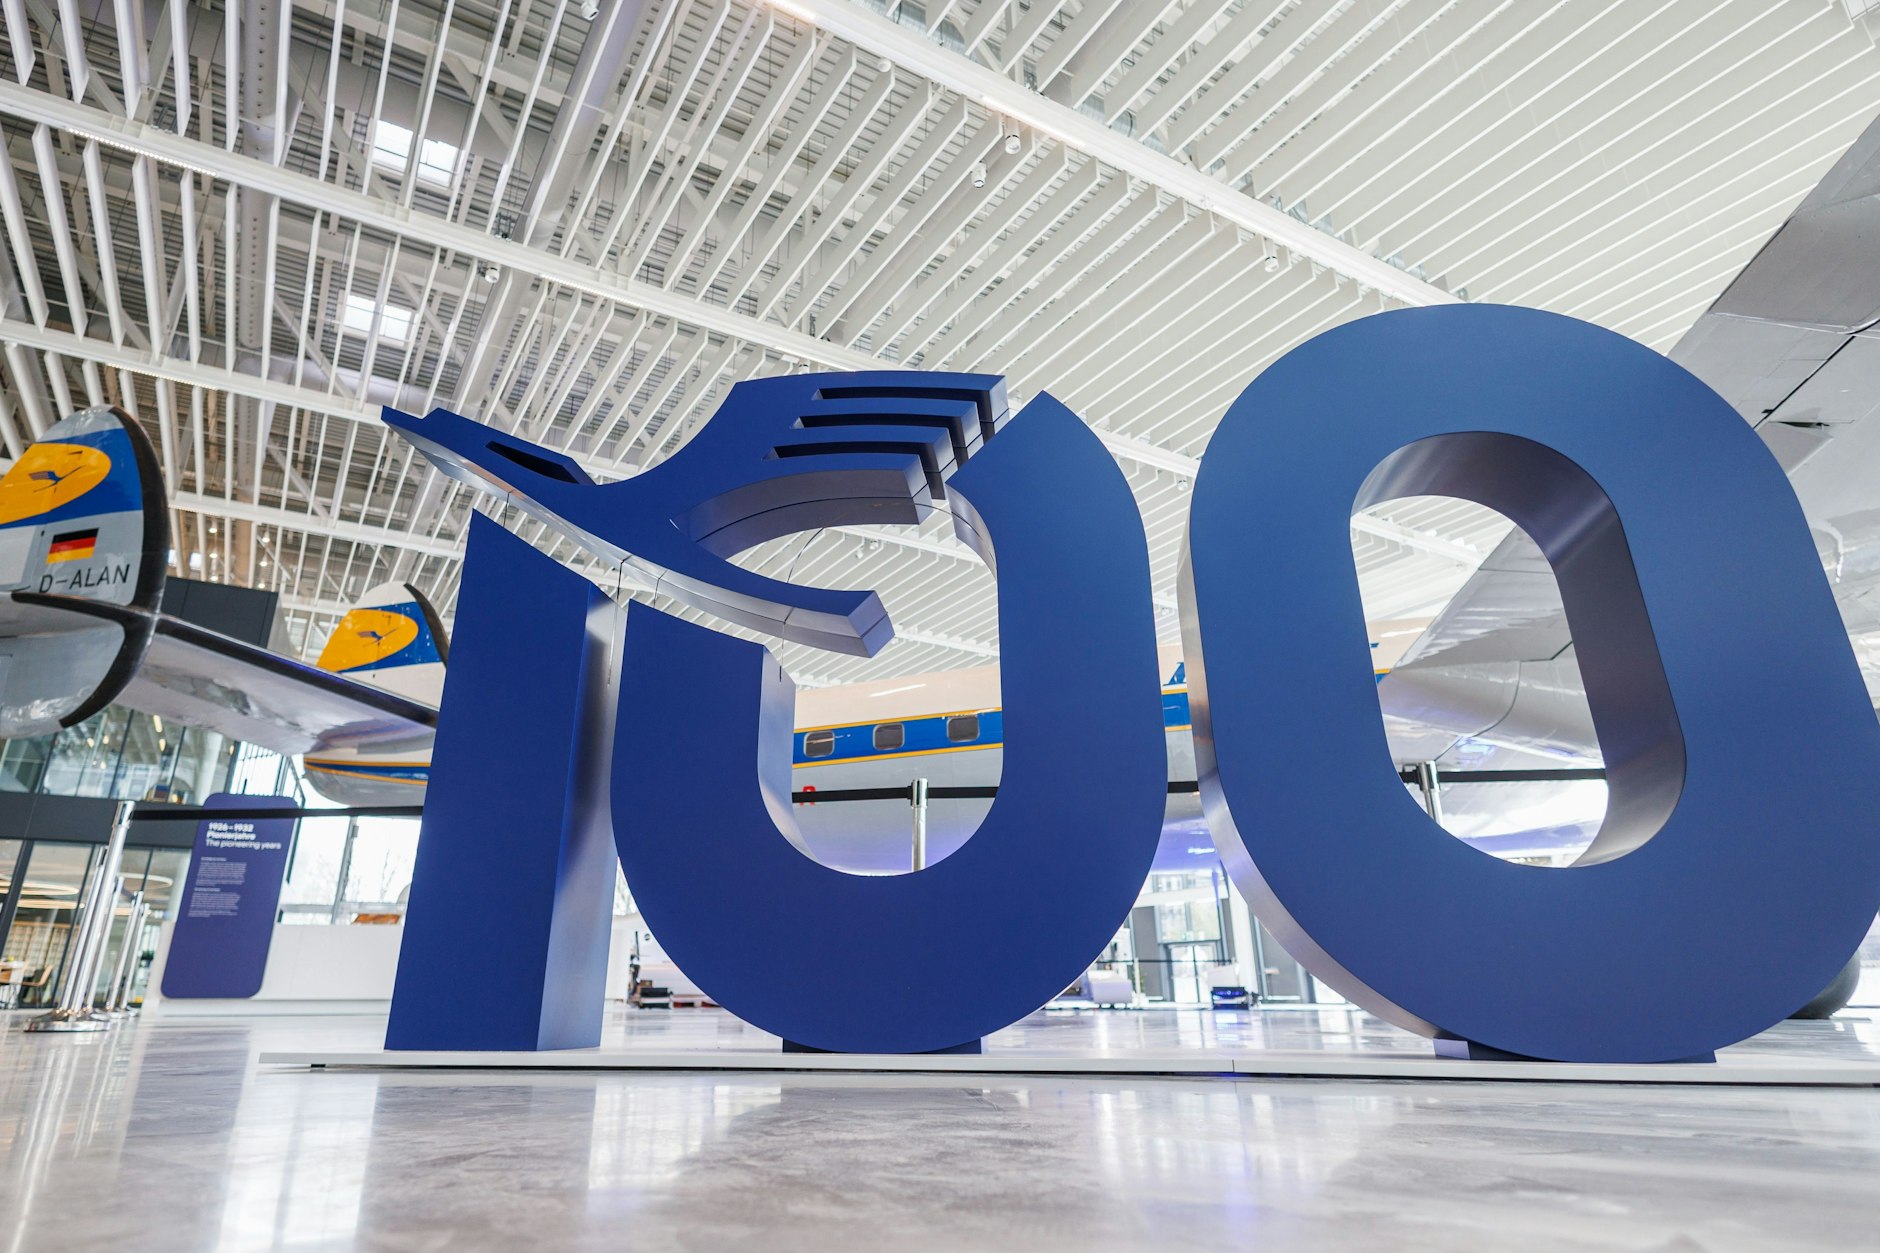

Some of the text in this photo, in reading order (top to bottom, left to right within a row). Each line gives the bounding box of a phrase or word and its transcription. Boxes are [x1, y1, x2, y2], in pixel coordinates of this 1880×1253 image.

[39, 564, 130, 593] D-ALAN
[220, 840, 261, 850] pioneering
[261, 842, 282, 850] years
